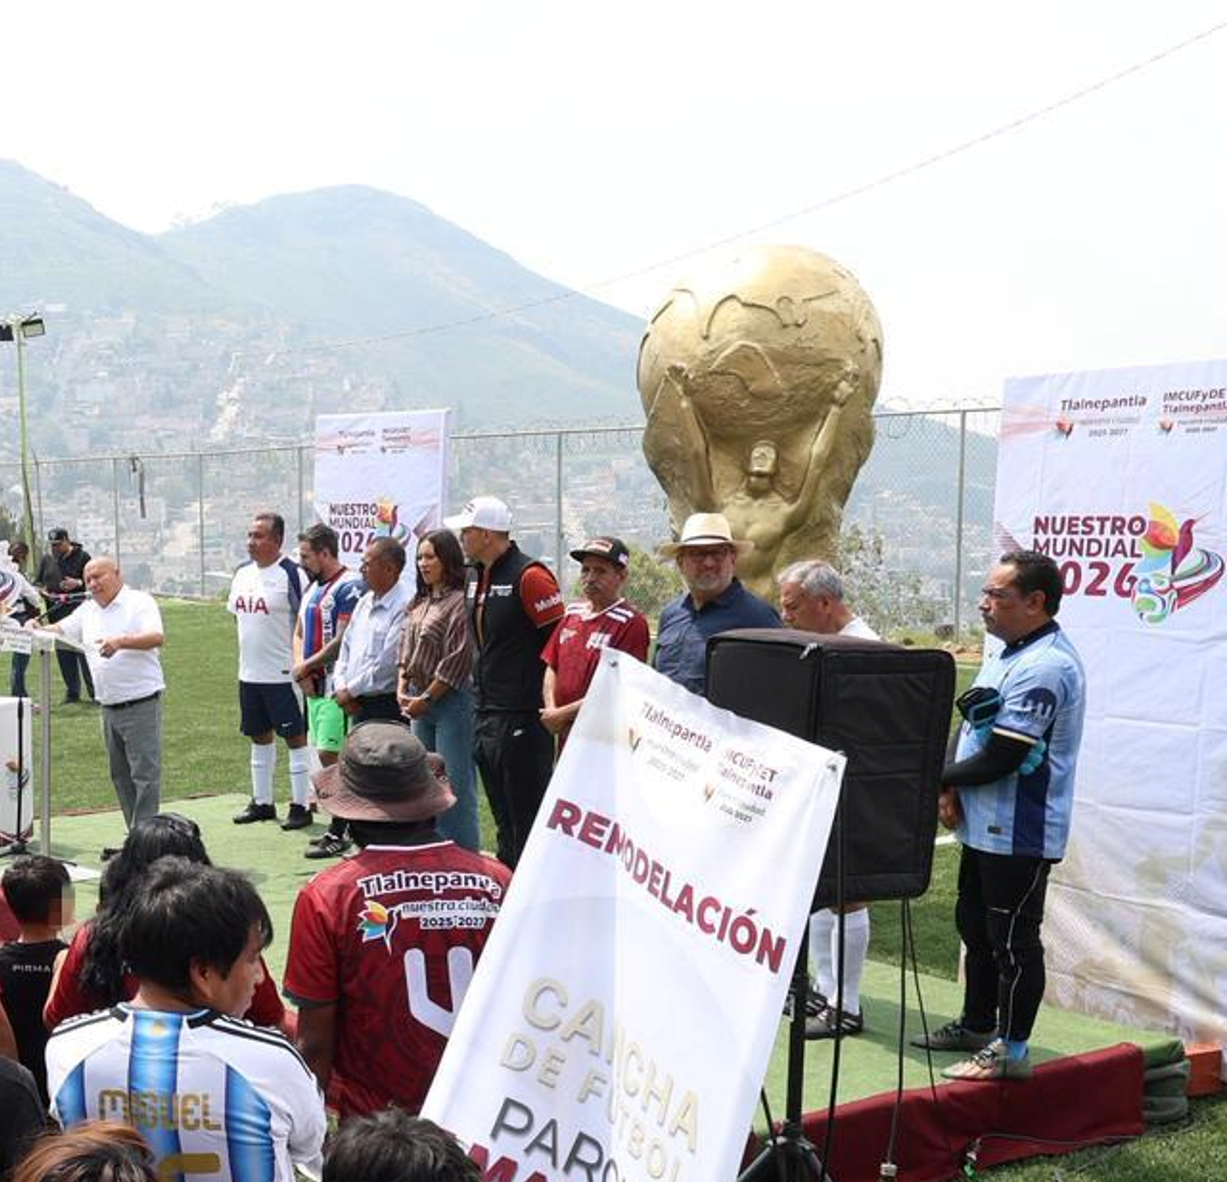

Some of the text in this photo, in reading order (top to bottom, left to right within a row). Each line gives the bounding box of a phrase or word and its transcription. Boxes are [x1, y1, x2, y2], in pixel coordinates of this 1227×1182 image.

[329, 502, 379, 516] NUESTRO
[1033, 516, 1147, 536] NUESTRO
[1032, 538, 1143, 559] MUNDIAL
[1056, 560, 1140, 598] 026
[235, 595, 270, 615] AIA
[547, 798, 787, 974] REMODELACIÓN
[12, 963, 51, 973] PIRMA
[500, 1032, 566, 1090] DE
[98, 1088, 222, 1131] MIGUEL
